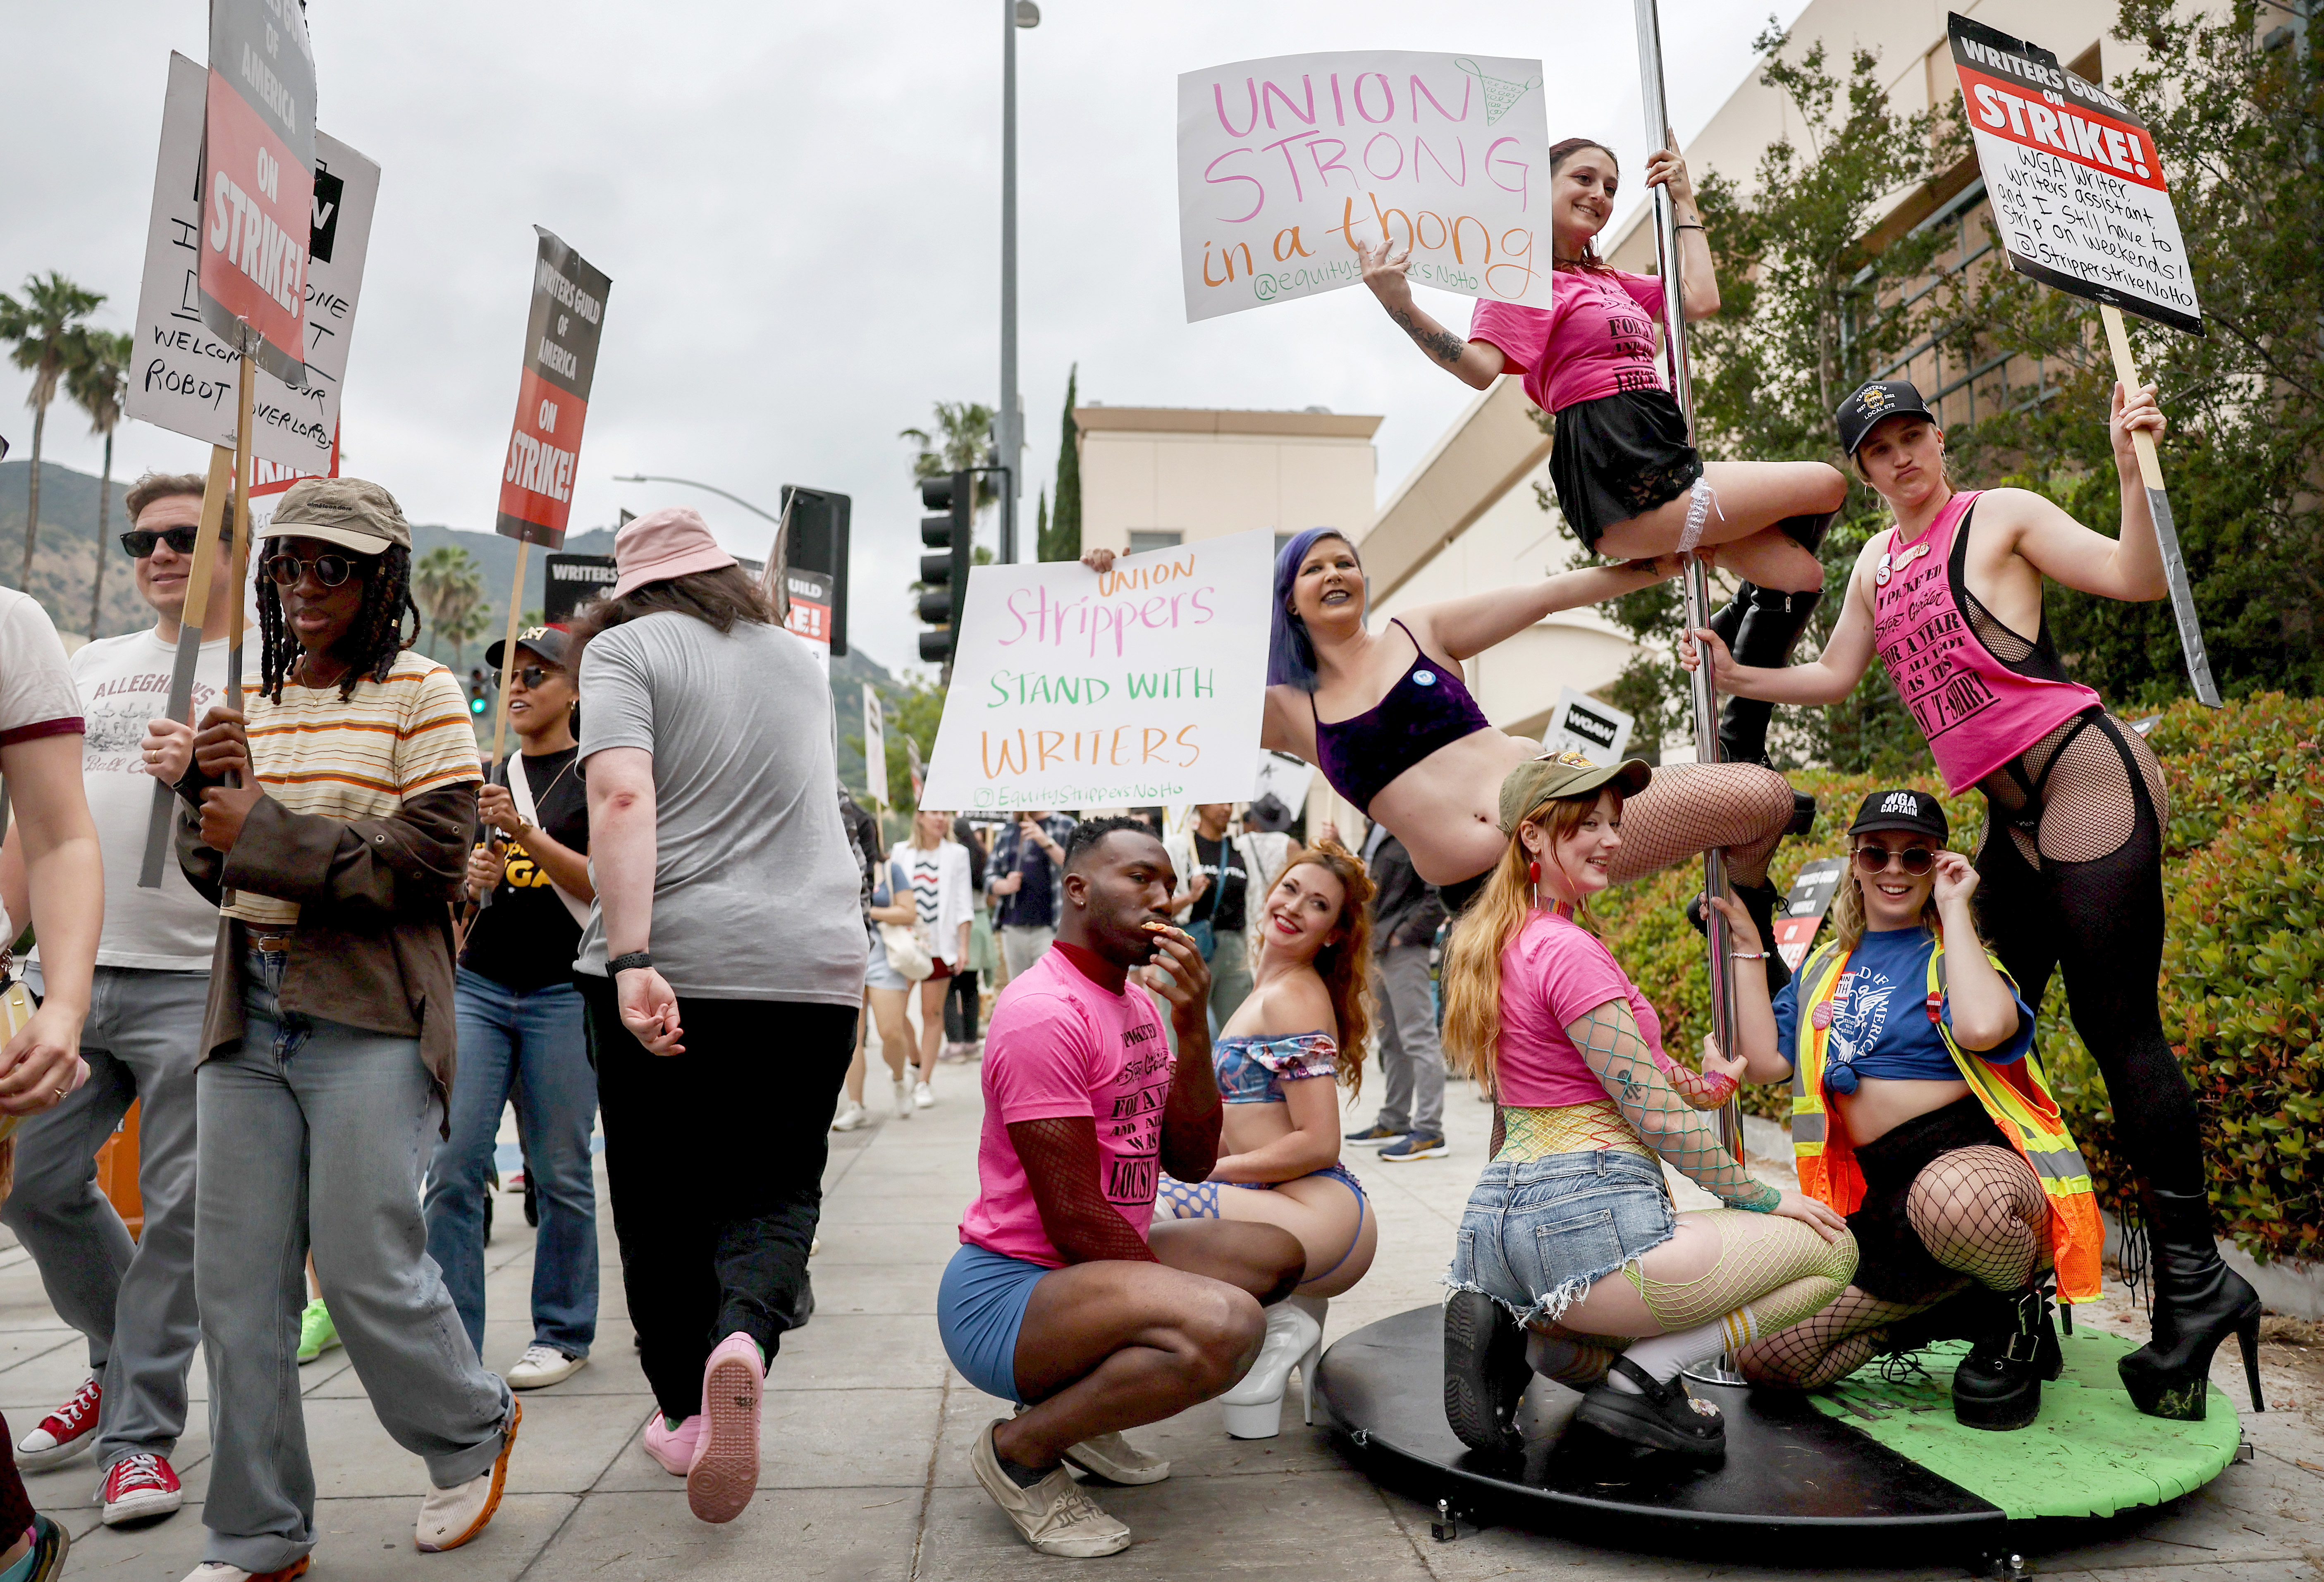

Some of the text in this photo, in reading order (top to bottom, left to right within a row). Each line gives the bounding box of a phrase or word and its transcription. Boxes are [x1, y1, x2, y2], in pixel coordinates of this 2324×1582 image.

[266, 22, 279, 59] OF
[241, 41, 295, 135] AMERICA
[1960, 36, 2128, 115] WRITERS GUILD
[1213, 72, 1470, 138] UNION
[2043, 89, 2065, 107] ON
[1974, 83, 2151, 179] STRIKE!
[258, 147, 278, 204] ON
[1204, 130, 1529, 222] STRONG
[2018, 146, 2066, 179] WGA
[1998, 183, 2028, 210] and
[2032, 195, 2052, 215] I
[2105, 216, 2147, 247] have
[2152, 232, 2171, 252] to
[2053, 225, 2078, 246] on
[210, 170, 304, 319] STRIKE!
[1204, 191, 1541, 299] in a thong
[541, 258, 601, 324] WRITERS GUILD
[558, 314, 569, 337] OF
[537, 336, 577, 381] AMERICA
[145, 358, 231, 410] ROBOT
[1856, 385, 1887, 402] TEAMSTERS
[539, 398, 558, 434] ON
[1864, 406, 1885, 420] LOCAL
[506, 429, 576, 503] STRIKE!
[552, 563, 619, 583] WRITERS
[788, 578, 822, 599] UILD
[1098, 554, 1195, 597] UNION
[998, 585, 1215, 658] Strippers
[1906, 637, 1918, 656] A
[1918, 613, 1961, 646] YEAR
[987, 666, 1213, 709] STAND WITH
[1930, 671, 1994, 727] T-SHIRT
[981, 723, 1200, 780] WRITERS
[1880, 804, 1918, 817] CAPTAIN
[1885, 792, 1917, 809] WGA
[504, 859, 552, 888] GA
[1812, 1016, 1827, 1025] UNION
[1813, 1011, 1830, 1020] STRIPPER
[1142, 1090, 1156, 1110] A
[1125, 1132, 1157, 1150] WAS
[1107, 1160, 1153, 1198] LOUSY
